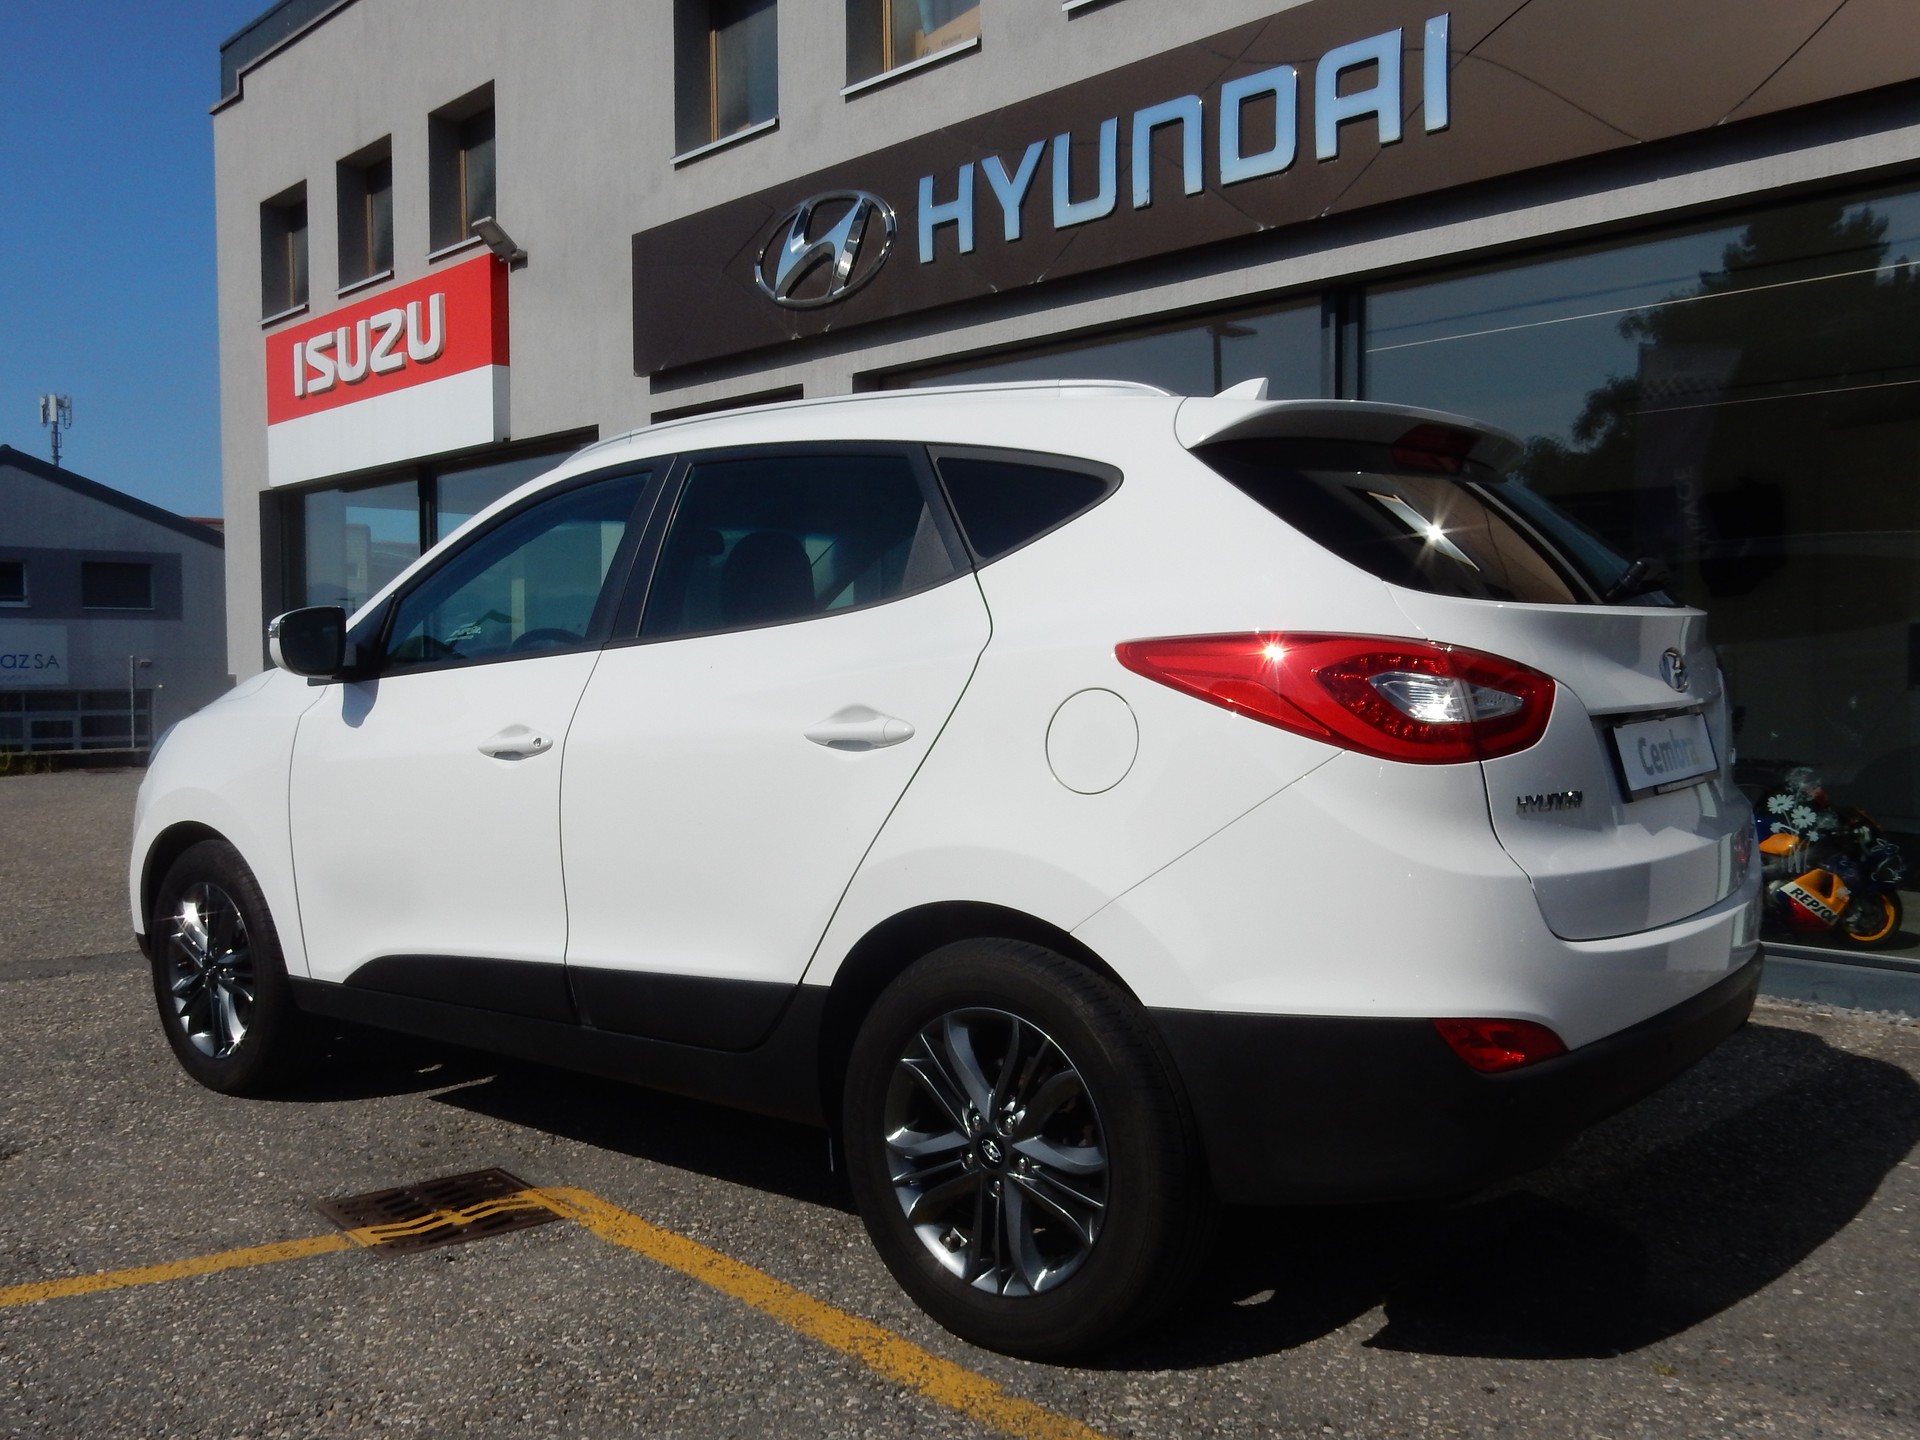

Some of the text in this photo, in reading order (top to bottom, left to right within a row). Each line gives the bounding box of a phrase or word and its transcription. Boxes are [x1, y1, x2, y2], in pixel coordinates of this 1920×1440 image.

[918, 12, 1449, 264] HYUNDAI
[293, 292, 446, 399] ISUZU
[1638, 729, 1701, 776] Cembra
